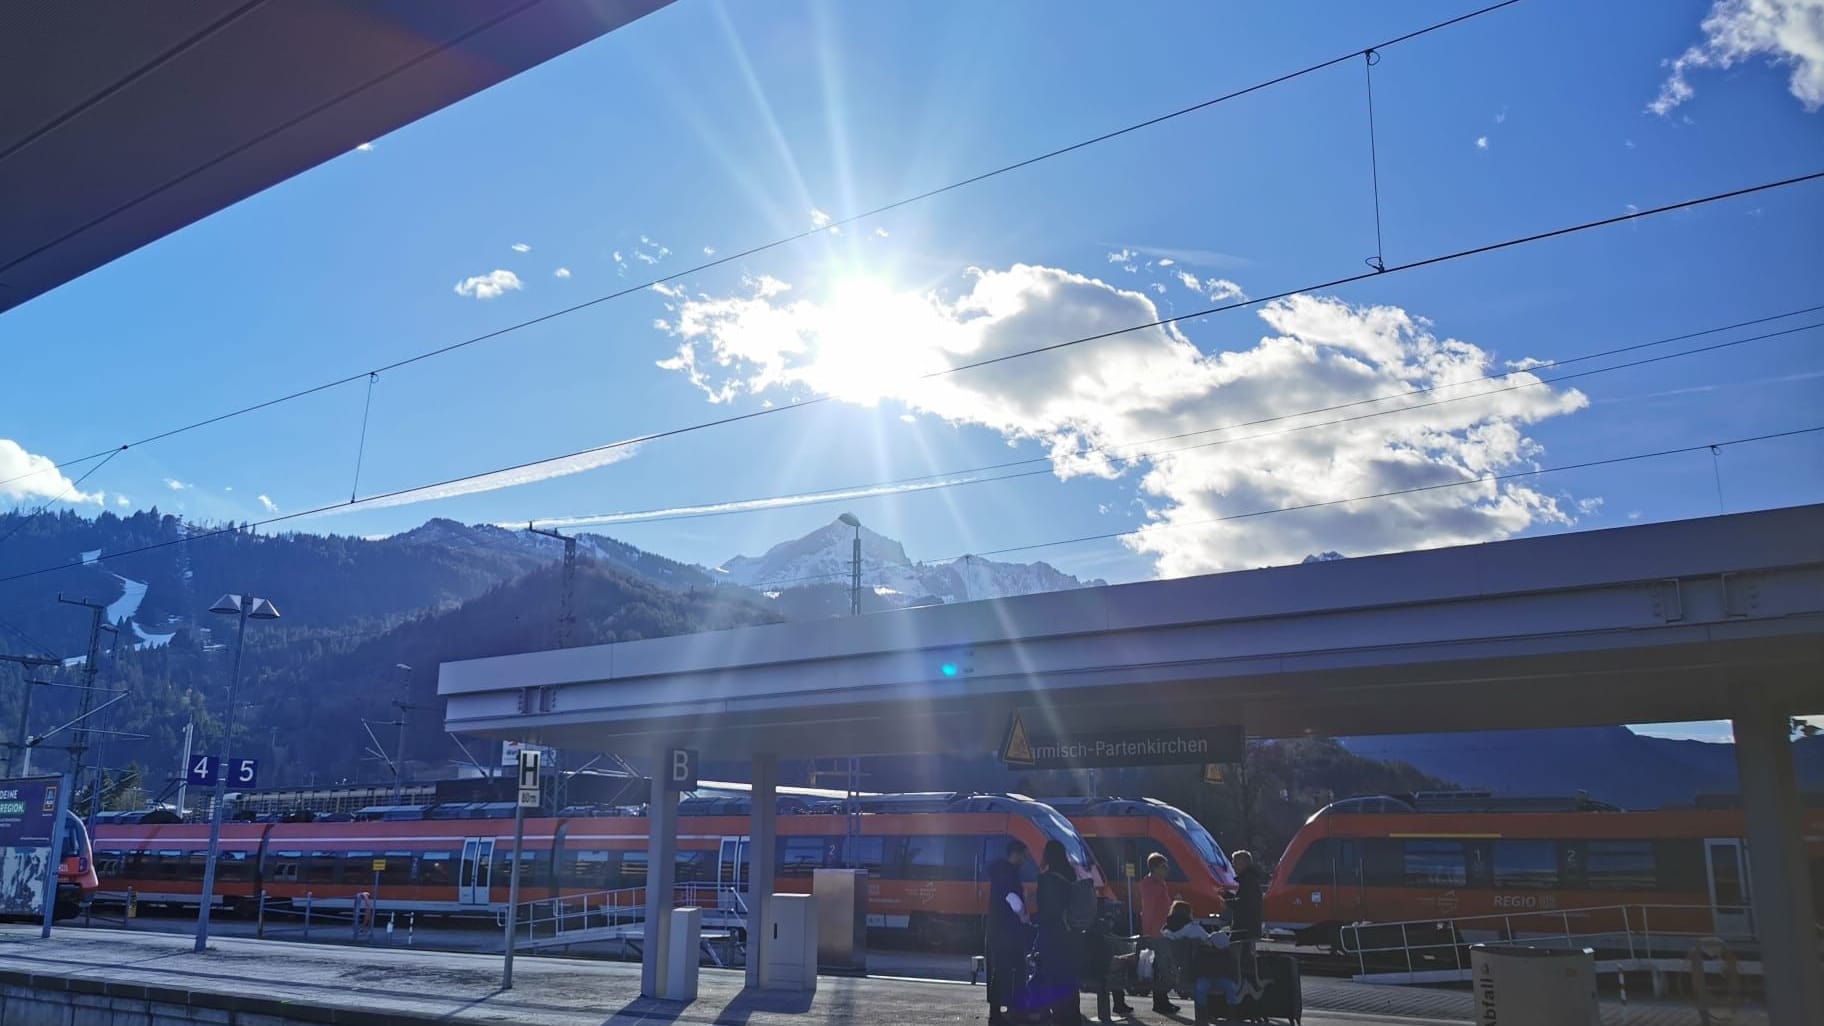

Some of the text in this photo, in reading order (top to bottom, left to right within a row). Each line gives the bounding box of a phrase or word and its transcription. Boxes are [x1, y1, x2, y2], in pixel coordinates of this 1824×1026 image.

[1030, 737, 1208, 760] armisch-Partenkirchen
[194, 756, 209, 779] 4
[239, 760, 254, 782] 5
[521, 753, 539, 787] H
[673, 750, 689, 781] B
[1566, 849, 1577, 862] 2
[1493, 895, 1537, 908] REGIO
